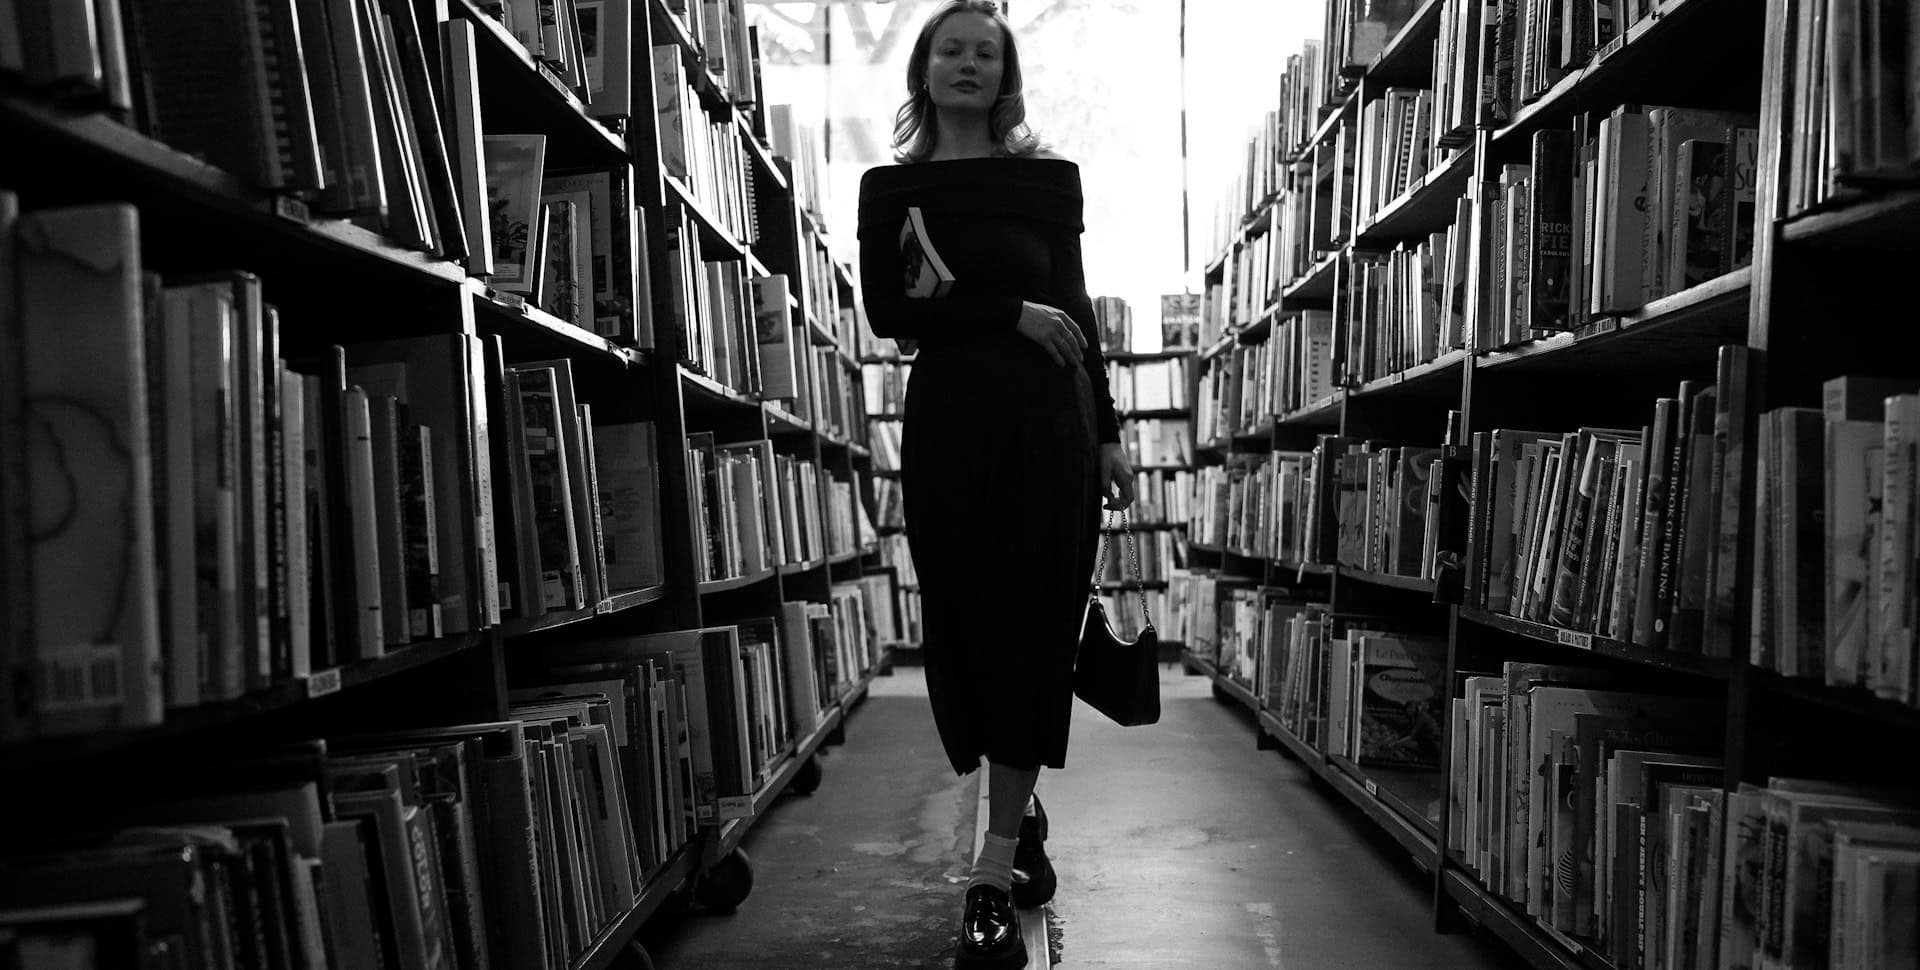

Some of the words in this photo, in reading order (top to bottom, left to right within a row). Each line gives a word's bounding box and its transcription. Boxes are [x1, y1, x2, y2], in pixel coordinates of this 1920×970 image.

[1671, 446, 1681, 472] BIG
[1666, 476, 1678, 519] BOOK
[1664, 520, 1673, 539] OF
[1657, 543, 1671, 600] BAKING
